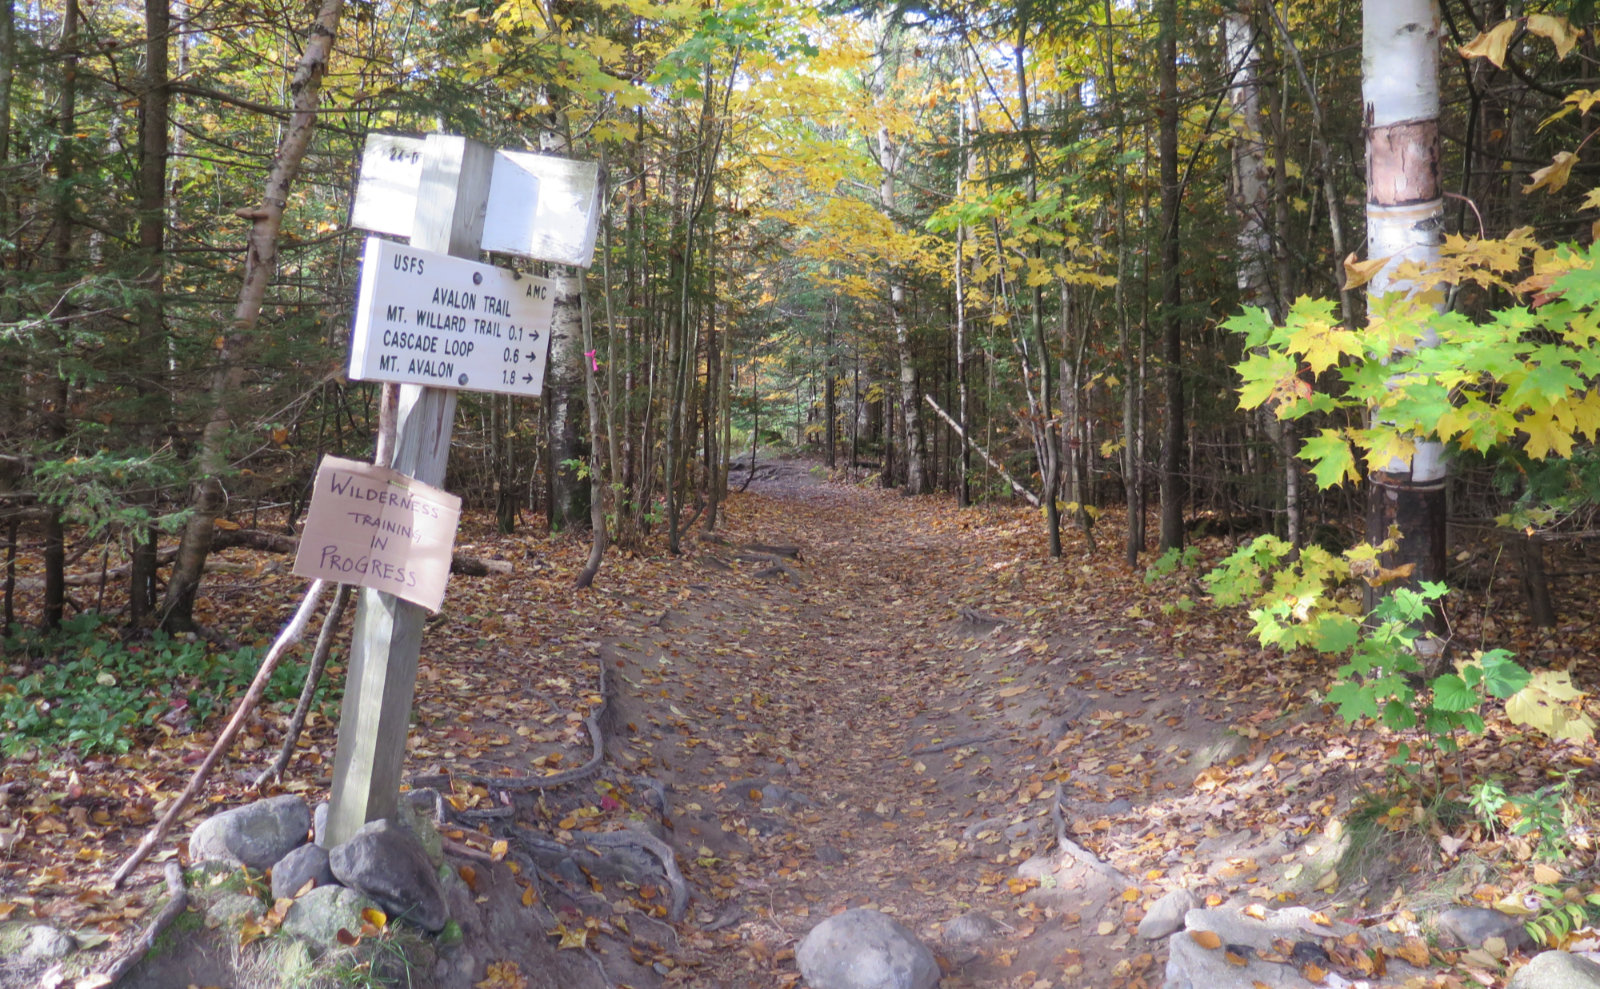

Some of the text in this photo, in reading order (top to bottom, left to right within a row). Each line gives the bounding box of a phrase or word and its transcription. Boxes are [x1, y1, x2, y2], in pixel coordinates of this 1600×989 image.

[393, 254, 425, 275] USFS
[432, 287, 511, 317] AVALON TRAIL
[526, 284, 547, 300] AMC
[386, 305, 523, 341] MT. WILLARD TRAIL 0.1
[383, 330, 519, 363] CASCADE LOOP 0.6
[379, 354, 515, 385] MT. AVALON 1.8
[331, 472, 439, 519] WILDERNESS
[347, 512, 422, 543] TRAINING
[370, 536, 388, 550] IN
[320, 545, 416, 587] PROGRESS
